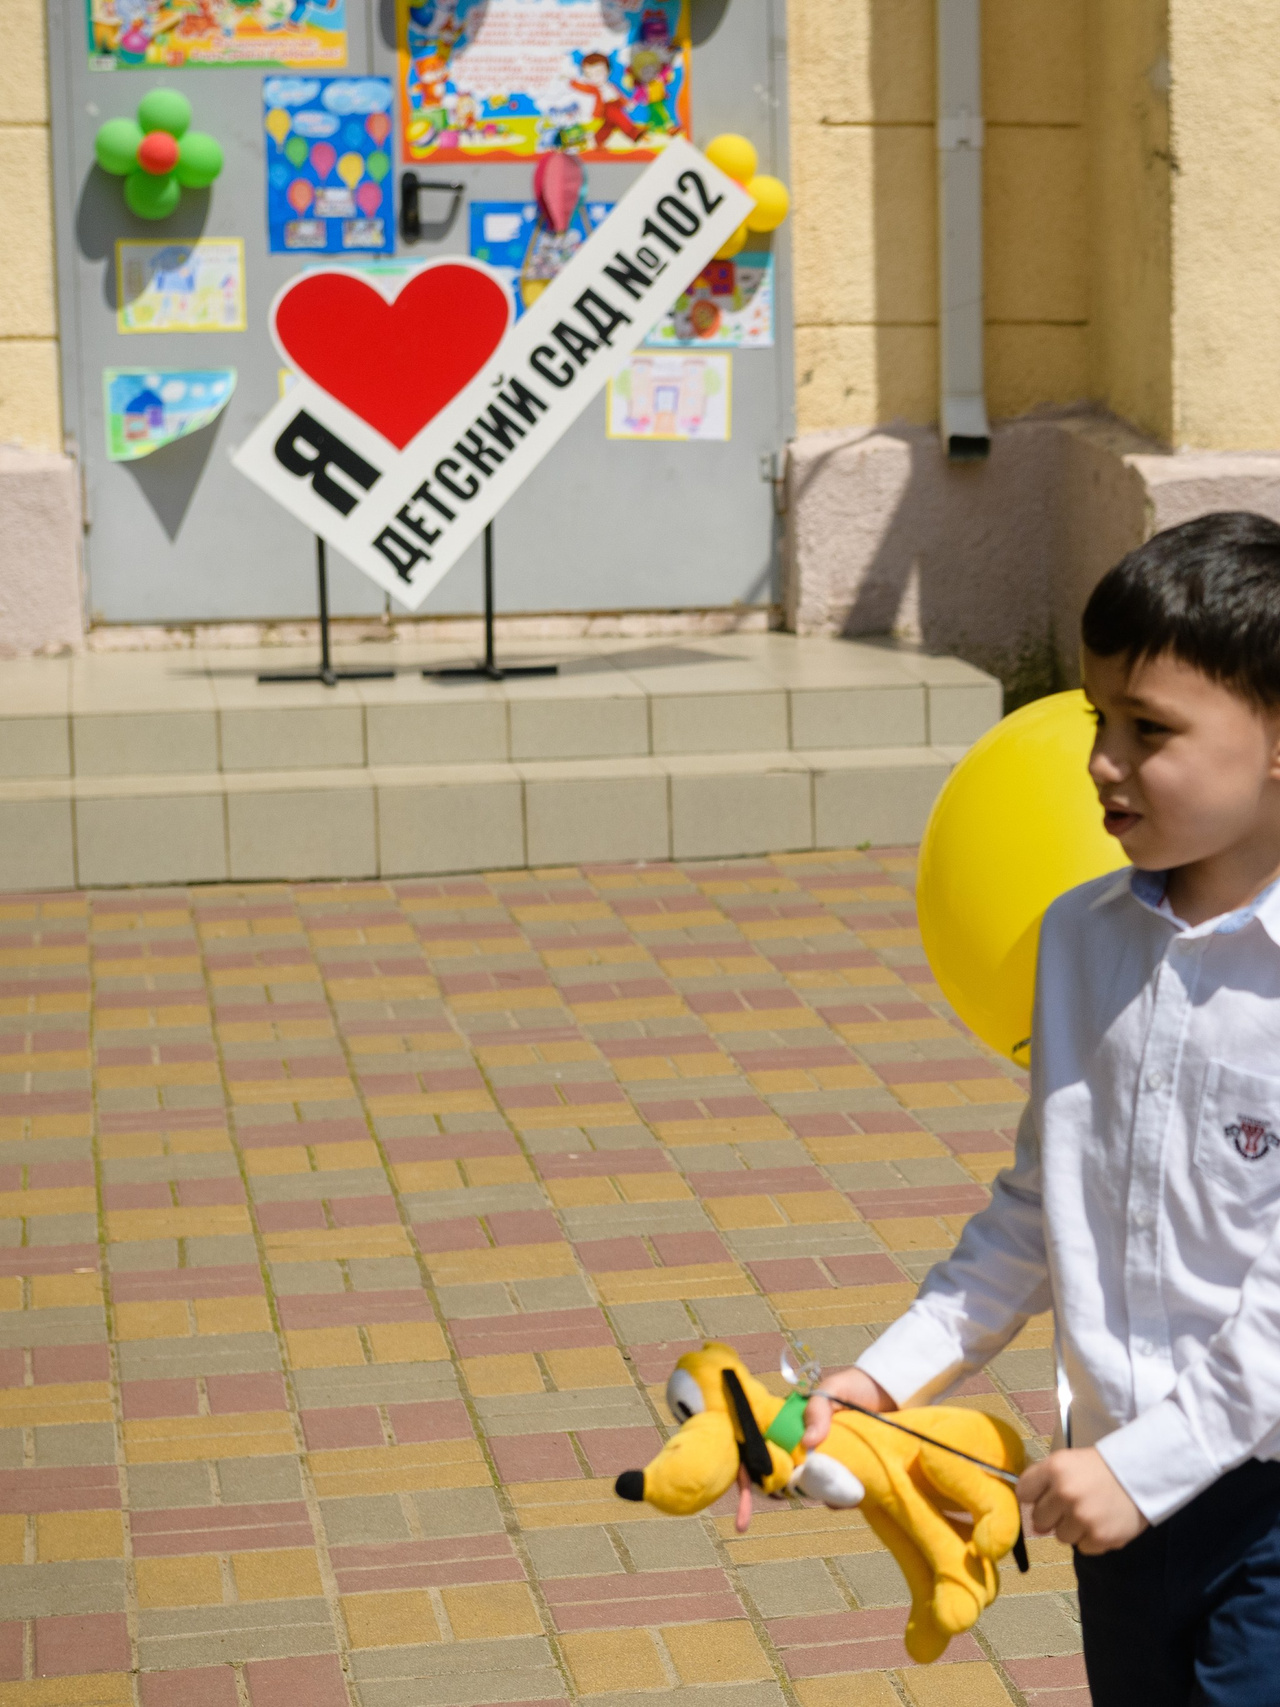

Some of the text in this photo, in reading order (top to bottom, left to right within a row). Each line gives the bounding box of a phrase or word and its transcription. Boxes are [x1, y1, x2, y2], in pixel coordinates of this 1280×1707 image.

[274, 409, 382, 517] Я
[371, 170, 727, 584] ДЕТСКИЙ САД №102
